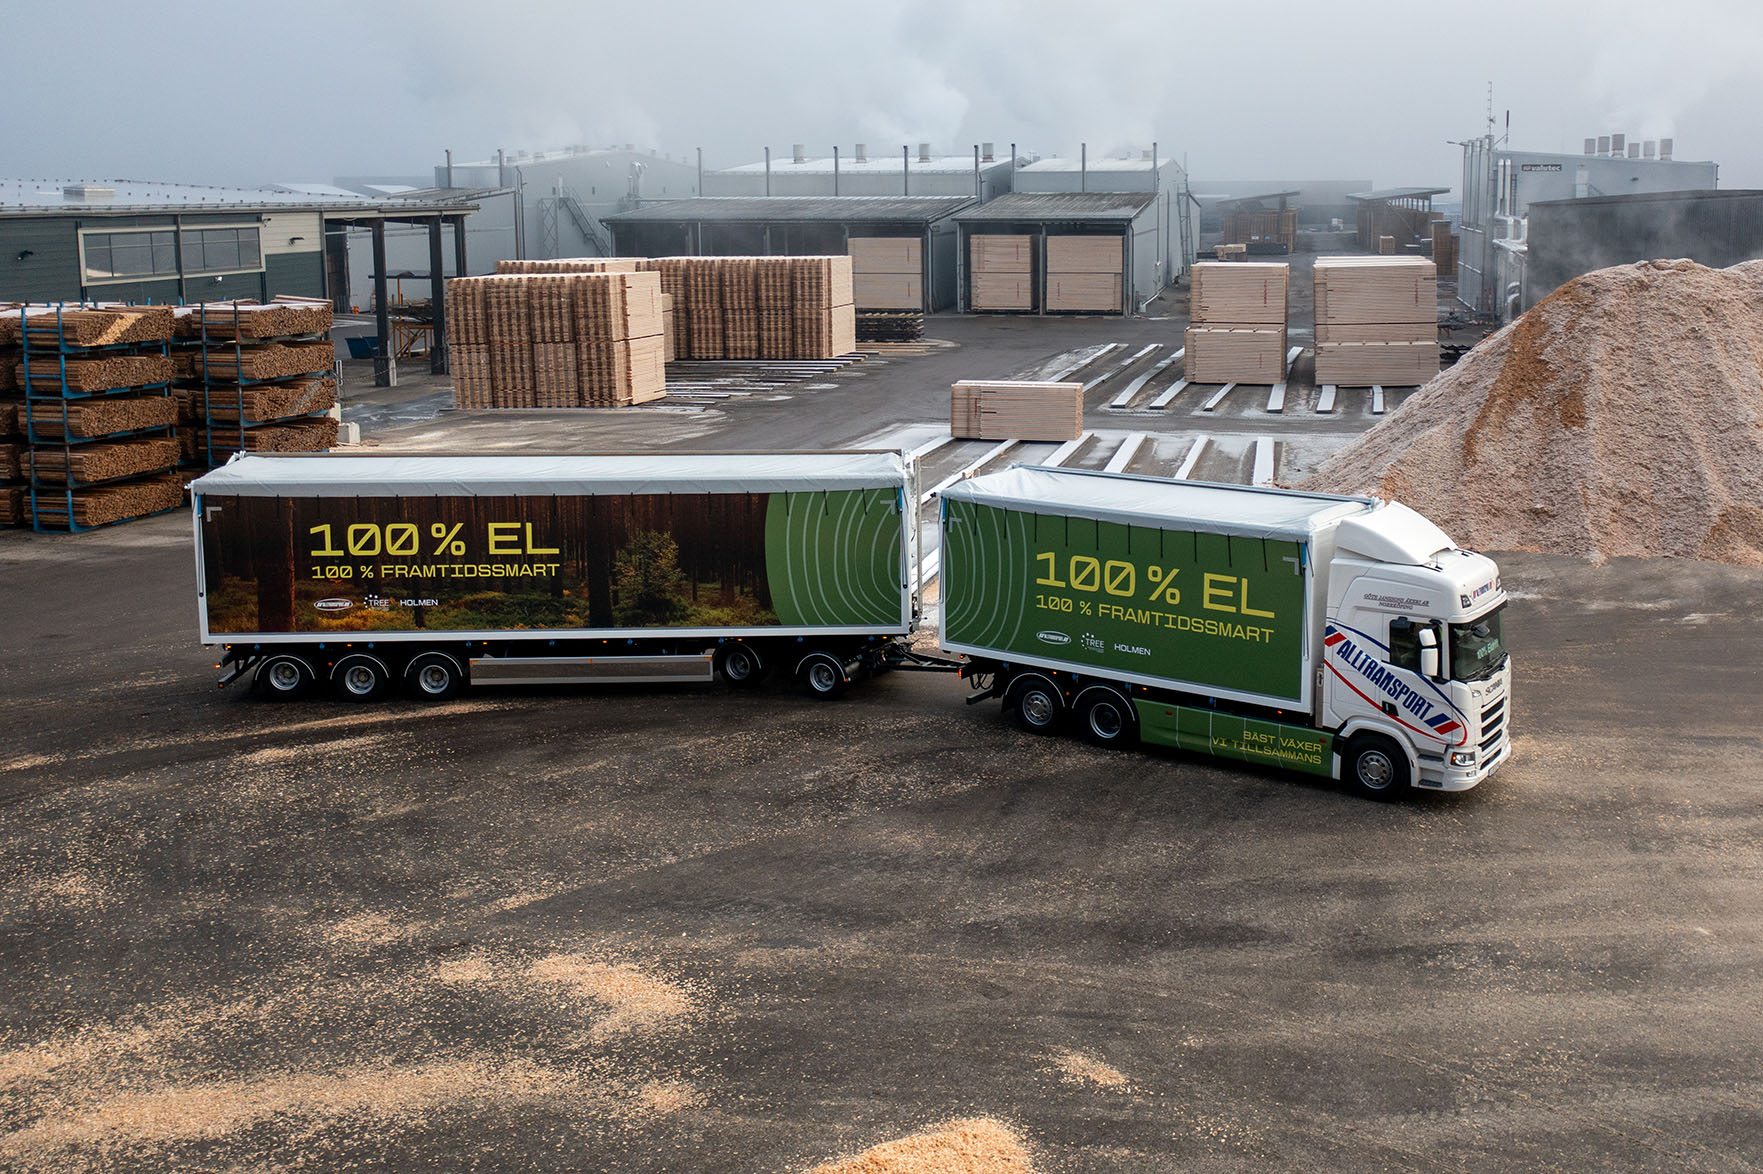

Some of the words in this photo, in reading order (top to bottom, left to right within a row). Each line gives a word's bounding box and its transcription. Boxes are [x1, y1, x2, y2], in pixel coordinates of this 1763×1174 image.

[487, 522, 560, 555] EL
[381, 563, 560, 578] FRAMTIDSSMART
[369, 599, 390, 607] TREE
[400, 599, 439, 607] HOLMEN
[1203, 572, 1276, 619] EL
[1098, 603, 1276, 644] FRAMTIDSSMART
[1085, 638, 1105, 649] TREE
[1114, 643, 1151, 656] HOLMEN
[1336, 639, 1435, 720] ALLTRANSPORT
[1211, 735, 1228, 747] VI
[1231, 740, 1322, 765] TILLSAMMANS
[1243, 730, 1276, 744] BÄST
[1279, 737, 1322, 753] VÄXER
